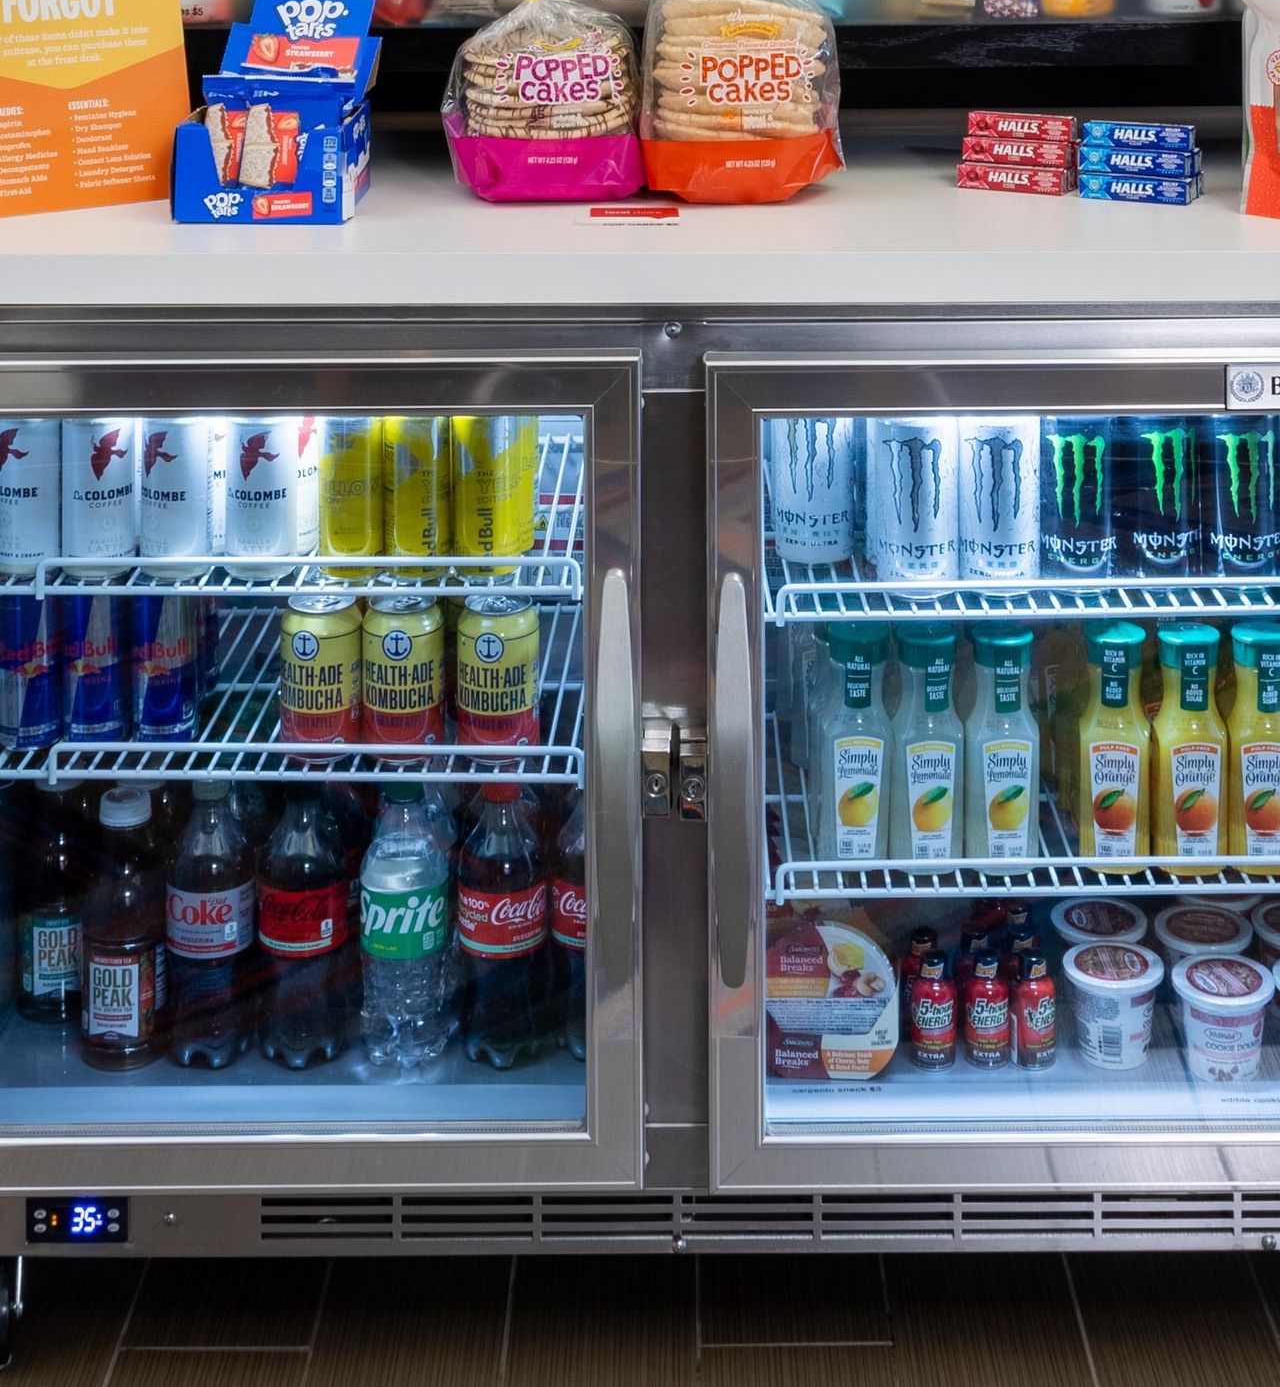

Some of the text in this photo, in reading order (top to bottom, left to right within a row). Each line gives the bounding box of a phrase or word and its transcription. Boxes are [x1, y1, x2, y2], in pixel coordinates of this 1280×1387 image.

[15, 33, 40, 43] these
[95, 27, 121, 37] make
[44, 44, 62, 54] you
[62, 43, 81, 53] can
[81, 39, 123, 51] purchase
[123, 37, 148, 48] them
[37, 54, 79, 66] the front
[284, 49, 335, 59] STRAWBERRY
[514, 52, 611, 82] POPPED
[700, 53, 803, 84] POPPED
[520, 78, 600, 103] cakes
[709, 80, 793, 104] cakes
[996, 120, 1040, 135] HALLS
[1113, 128, 1157, 142] HALLS
[992, 144, 1035, 159] HALLS
[77, 157, 105, 166] Contact
[1110, 154, 1154, 168] HALLS
[78, 168, 110, 177] Laundry
[84, 482, 134, 502] COLOMBE
[234, 487, 288, 501] COLOMBE
[878, 538, 956, 560] MONSTER
[366, 686, 435, 712] KOMBUCHA
[458, 687, 527, 713] KOMBUCHA
[838, 749, 879, 770] Simply
[911, 754, 952, 774] Simply
[837, 766, 880, 780] Lemonade
[910, 770, 952, 784] Lemonade
[1094, 770, 1136, 788] Orange
[1175, 769, 1216, 787] Orange
[170, 894, 233, 927] Coke
[360, 885, 446, 938] Sprite
[779, 955, 824, 965] Balanced
[779, 963, 814, 972] Breaks
[92, 987, 133, 1008] PEAK
[917, 1014, 953, 1028] ENERGY
[774, 1049, 819, 1060] Balanced
[917, 1051, 945, 1060] EXTRA
[972, 1050, 1001, 1059] EXTRA
[775, 1058, 810, 1067] Breaks
[71, 1206, 96, 1233] 35
